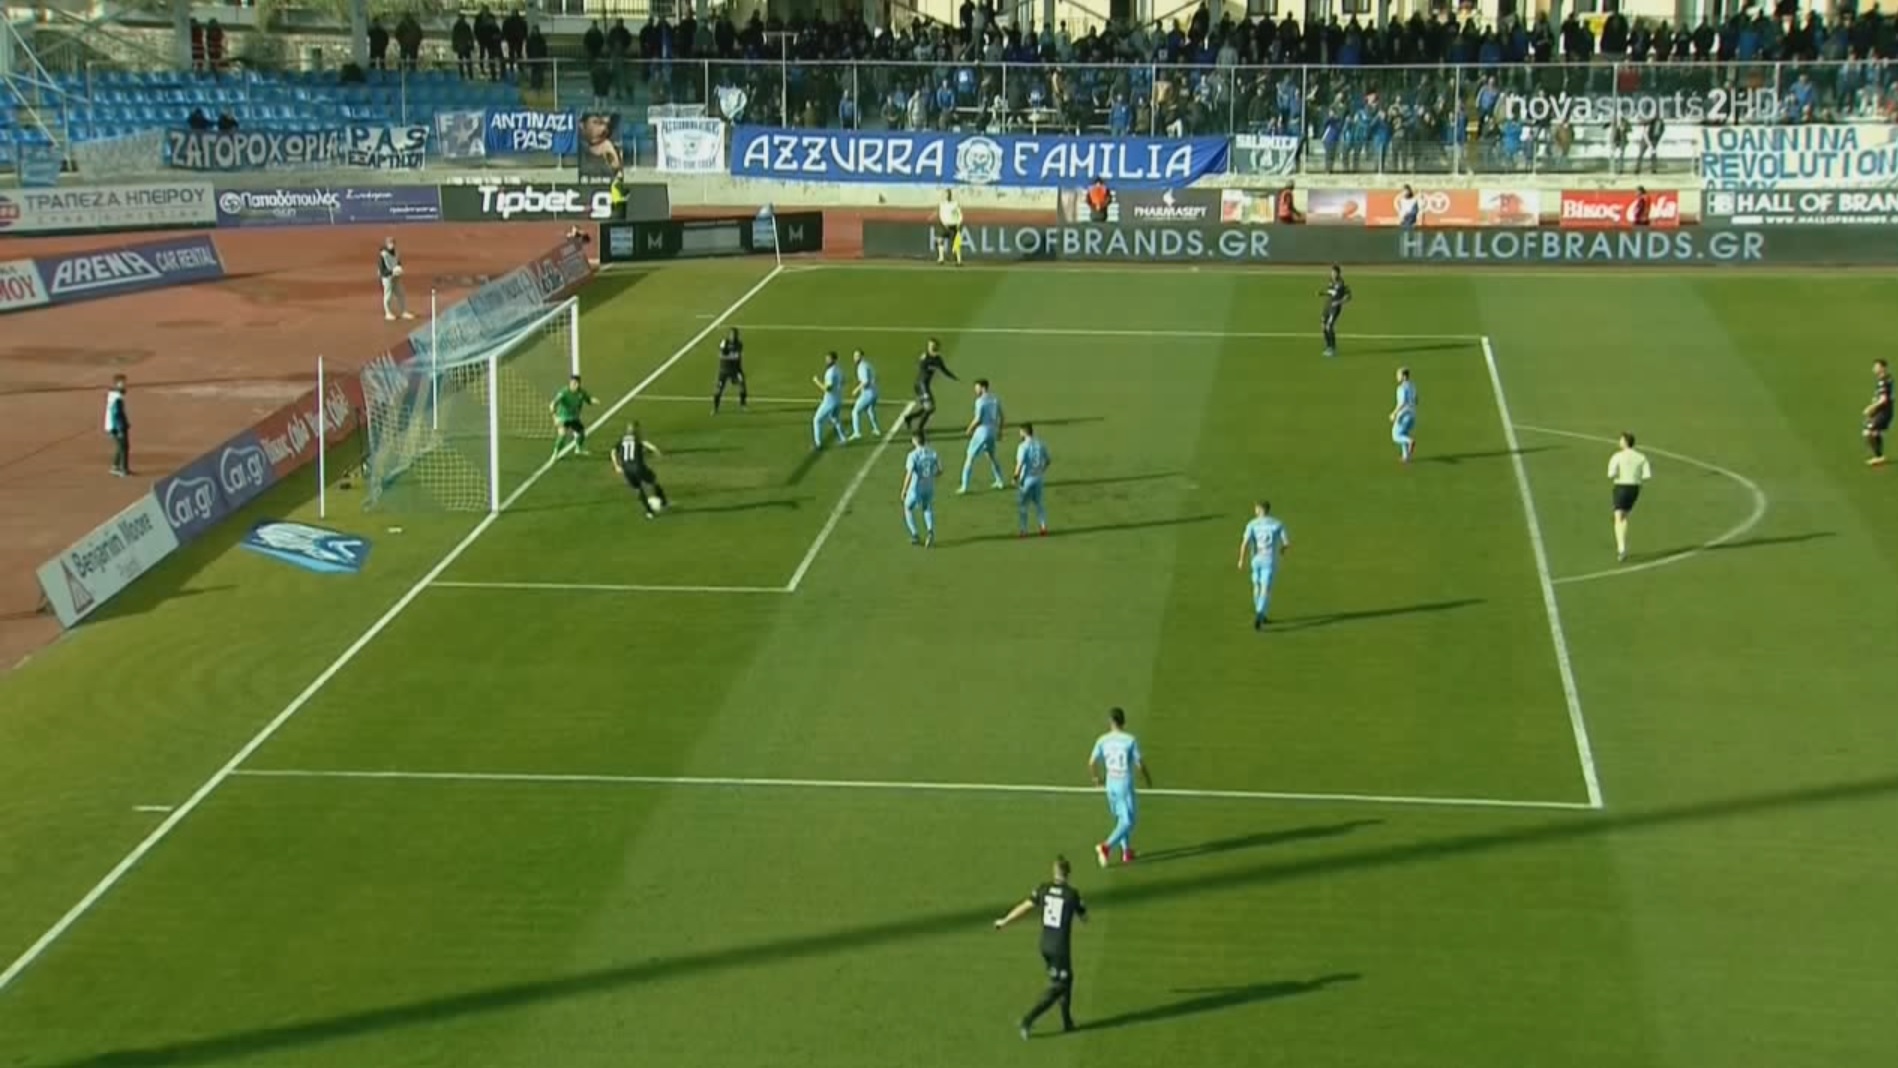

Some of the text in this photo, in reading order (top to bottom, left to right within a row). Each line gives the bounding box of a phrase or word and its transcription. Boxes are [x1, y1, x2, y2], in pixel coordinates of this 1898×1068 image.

[491, 111, 574, 131] ANTINAZI
[513, 130, 553, 150] PAS
[1702, 127, 1858, 151] IOANNINA
[1014, 141, 1192, 179] FAMILIA
[1701, 149, 1898, 178] REVOLUTION
[24, 188, 205, 211] ΤΡΑΠΕΖΑ ΗΠΕΙΡΟΥ
[478, 185, 613, 219] Tipbet.g
[1626, 196, 1677, 222] Cla
[1737, 192, 1795, 213] HALL
[1800, 192, 1833, 213] OF
[1402, 230, 1764, 259] HALLOFBRANDS.GR
[52, 252, 160, 290] ARENA
